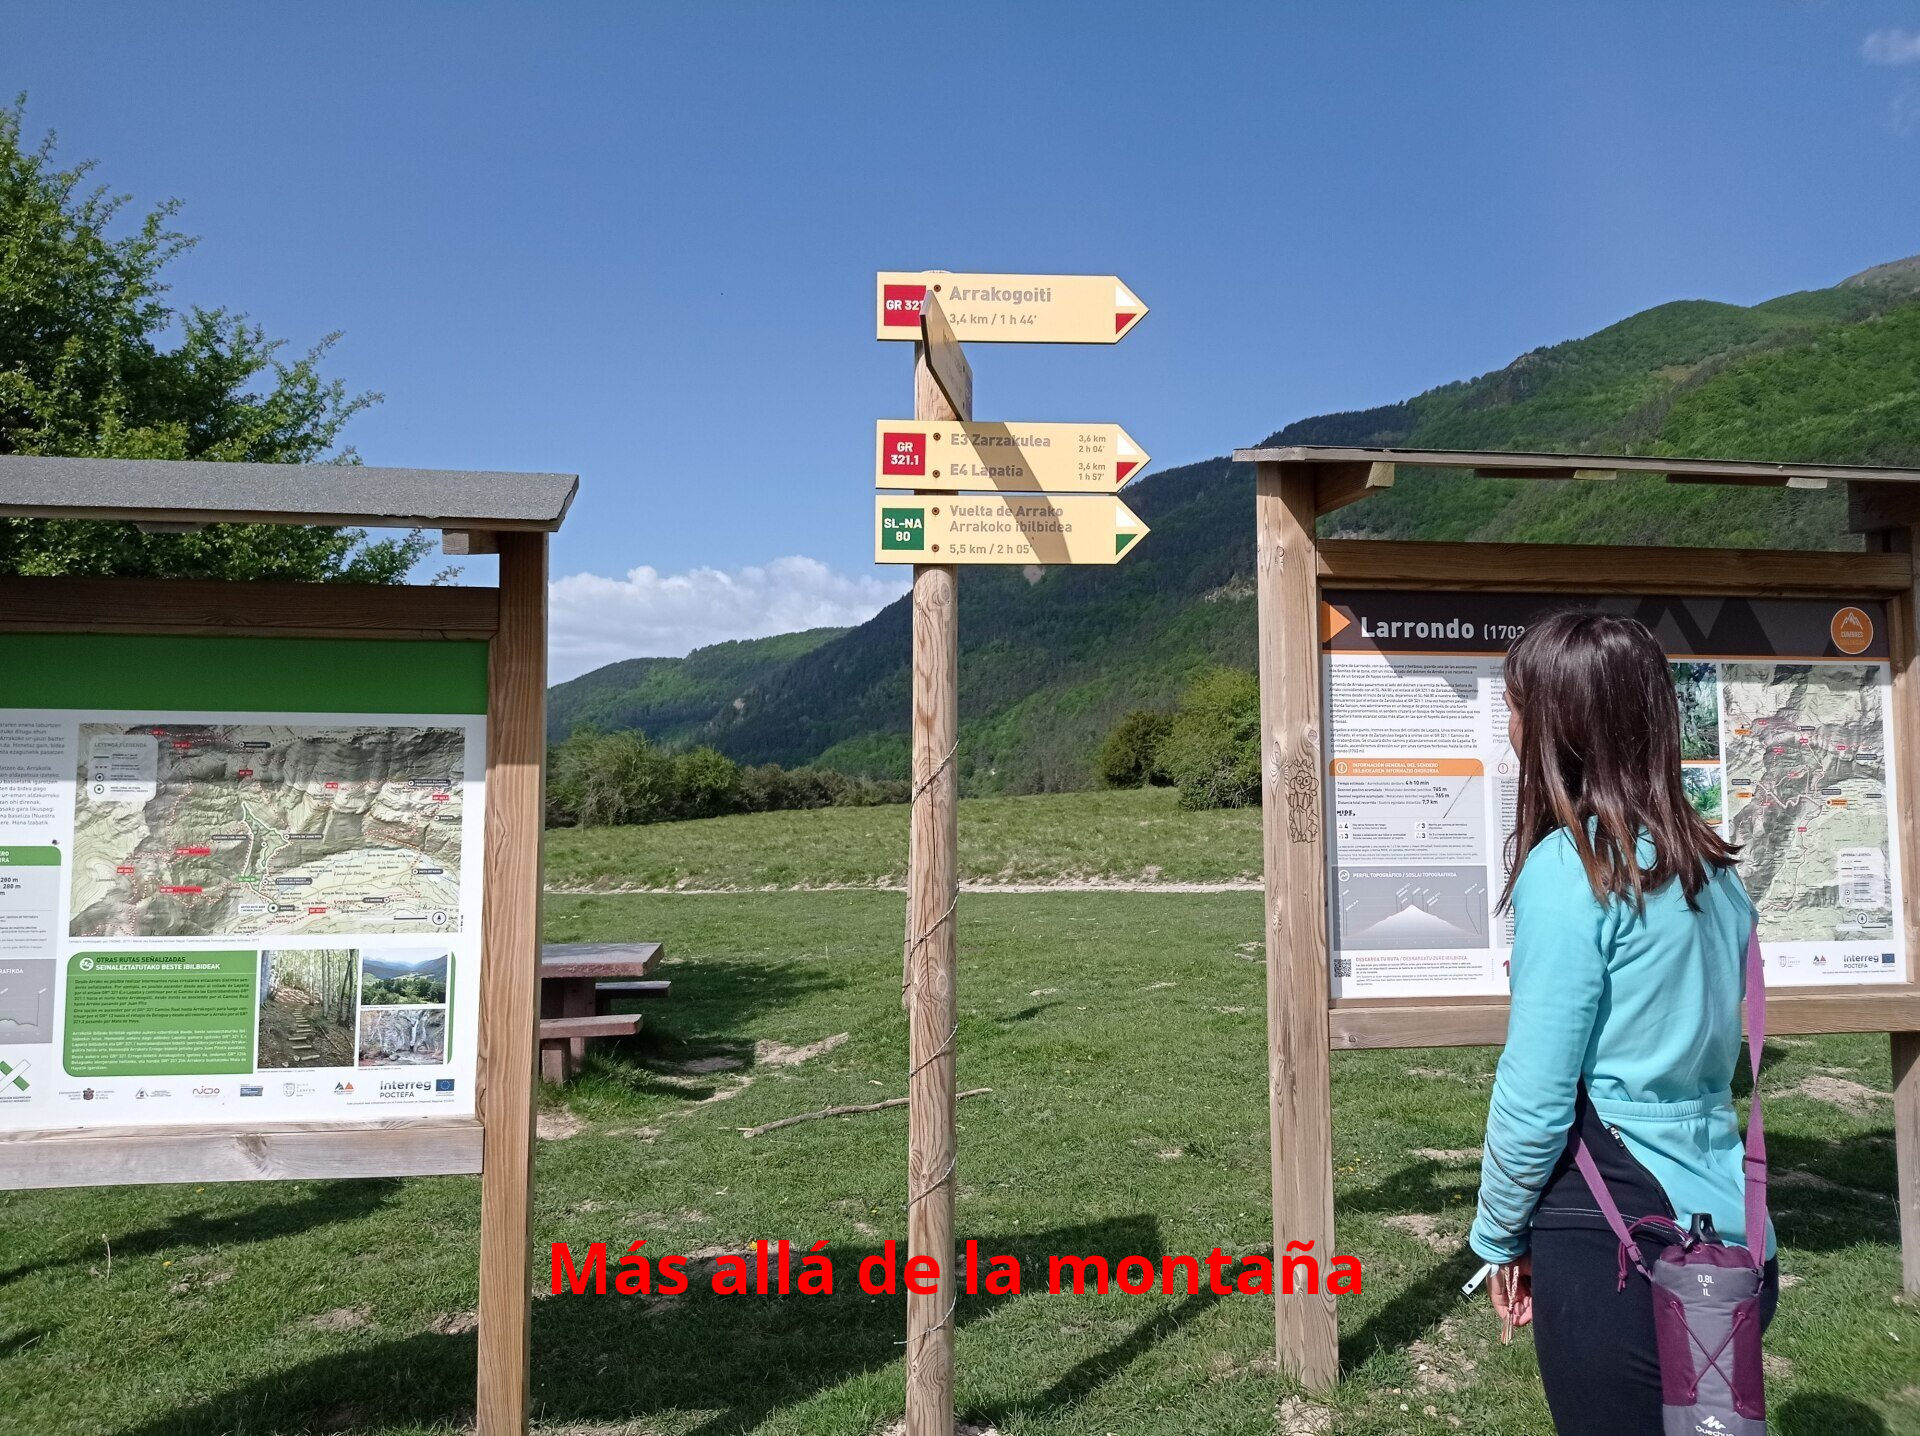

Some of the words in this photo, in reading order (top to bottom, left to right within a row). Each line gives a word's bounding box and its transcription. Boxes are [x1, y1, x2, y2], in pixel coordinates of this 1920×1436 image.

[949, 286, 1052, 305] Arrakogoiti
[886, 300, 902, 310] GR
[950, 314, 966, 325] 3,4
[970, 314, 988, 324] km
[991, 314, 997, 325] /
[1000, 314, 1005, 324] 1
[1010, 314, 1017, 324] h
[950, 433, 968, 445] E3
[972, 434, 1051, 447] Zarzakulea
[1078, 435, 1091, 443] 3,6
[896, 442, 913, 452] GR
[890, 454, 919, 465] 321.1
[950, 464, 967, 476] E4
[972, 464, 1023, 478] Lapatia
[1078, 463, 1091, 471] 3,6
[950, 505, 992, 517] Vuelta
[996, 505, 1012, 517] de
[1016, 505, 1063, 517] Arrako
[884, 518, 923, 529] SL-NA
[949, 521, 1011, 532] Arrakoko
[1016, 520, 1072, 533] ibilbidea
[895, 531, 910, 542] 80
[950, 544, 966, 555] 5,5
[969, 544, 987, 554] km
[989, 544, 995, 555] /
[997, 544, 1003, 554] 2
[1007, 544, 1013, 554] h
[1361, 616, 1474, 639] Larrondo
[1484, 625, 1525, 640] (1703
[1844, 954, 1879, 963] Interreg
[380, 1081, 431, 1091] Interreg
[1698, 1274, 1714, 1284] 0.8L
